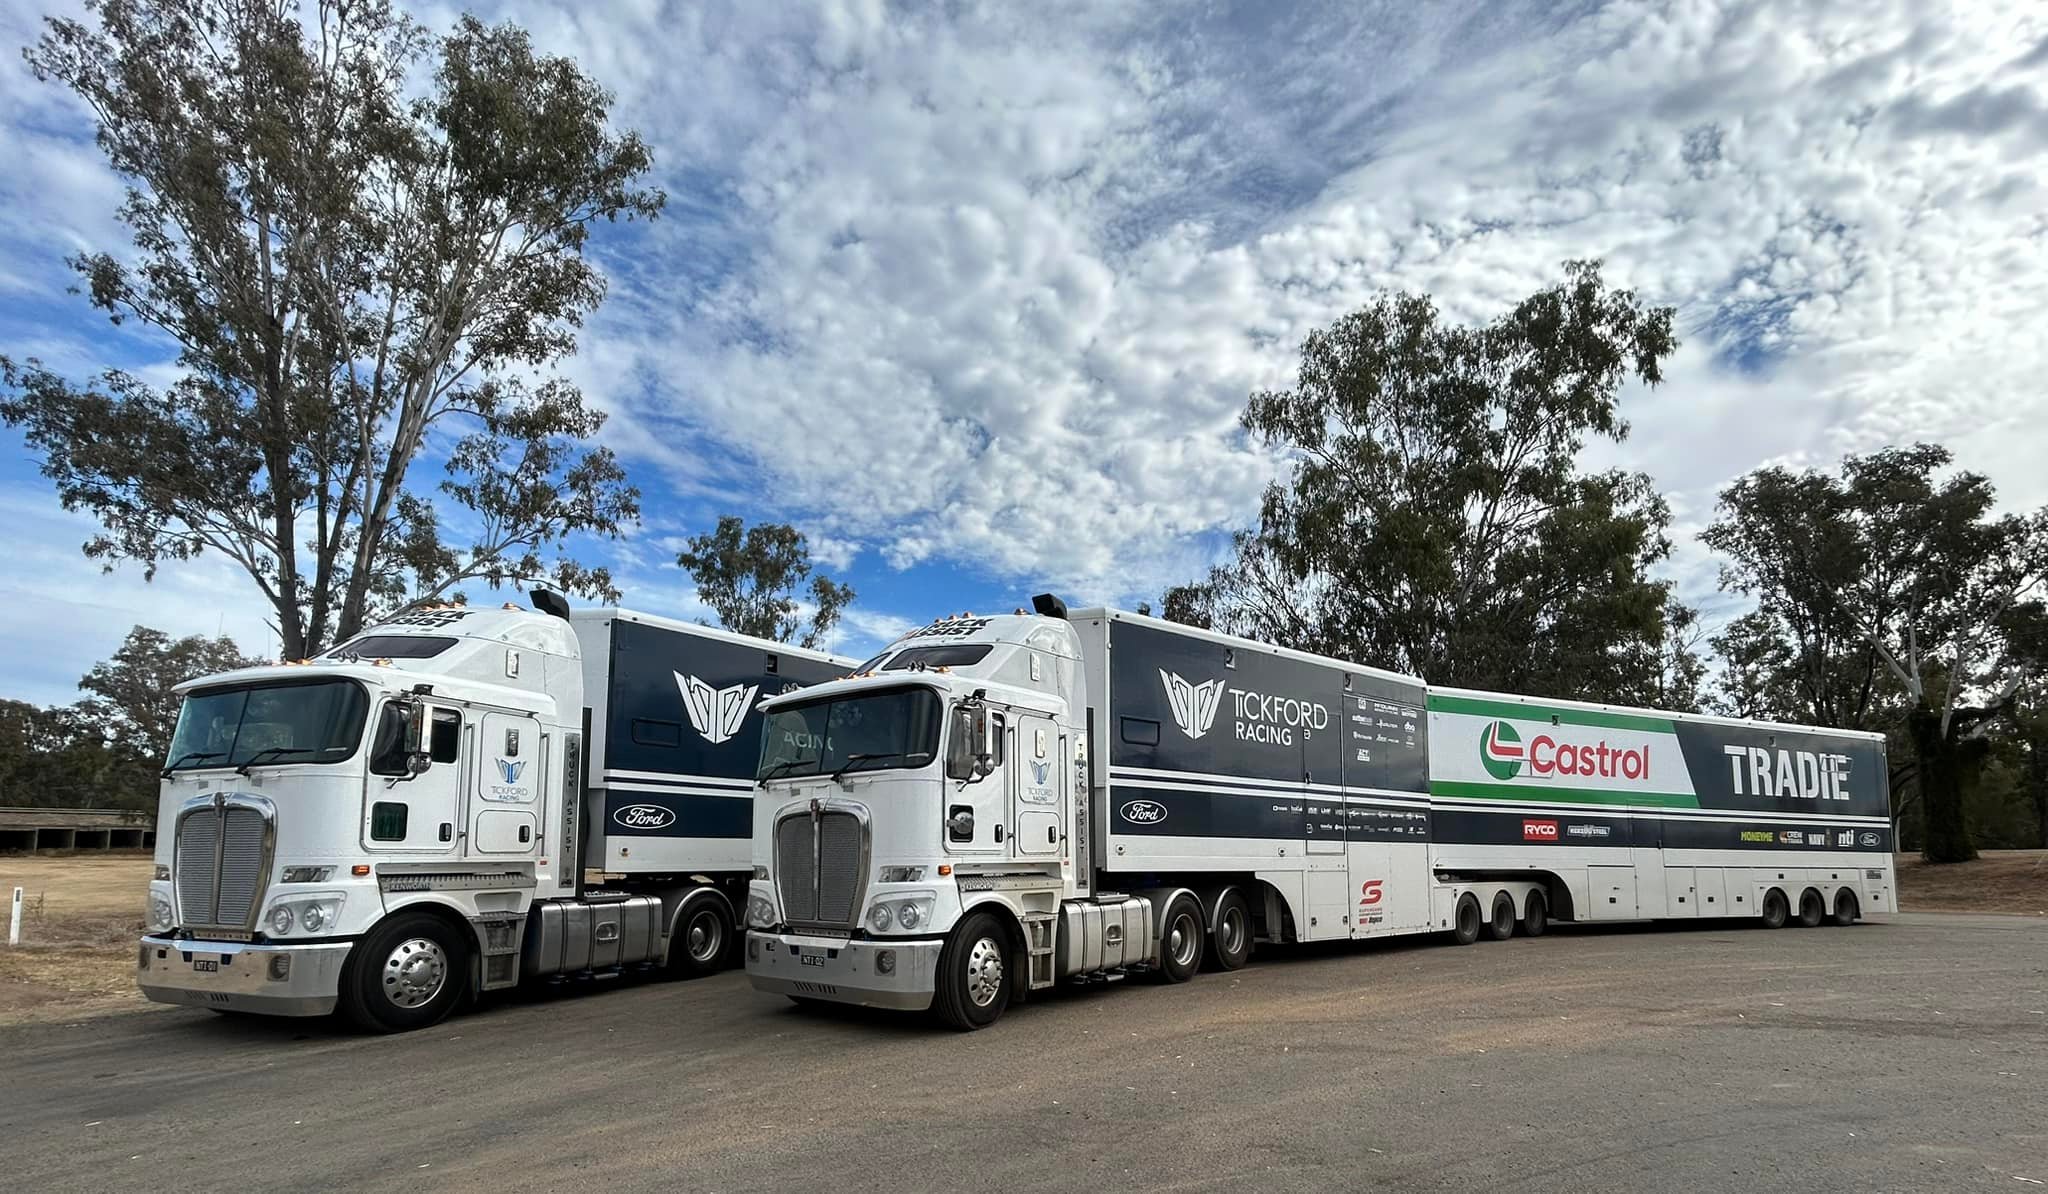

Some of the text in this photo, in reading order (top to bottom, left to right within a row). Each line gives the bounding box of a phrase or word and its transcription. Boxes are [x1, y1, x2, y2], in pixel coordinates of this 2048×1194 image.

[1228, 688, 1328, 730] TICKFORD
[1235, 721, 1292, 746] RACING
[1530, 735, 1649, 780] Castrol
[1724, 744, 1850, 800] TRADIE
[565, 799, 574, 853] ASSIST
[626, 807, 665, 825] Ford
[1129, 803, 1159, 820] Ford
[1524, 824, 1556, 835] RYCO
